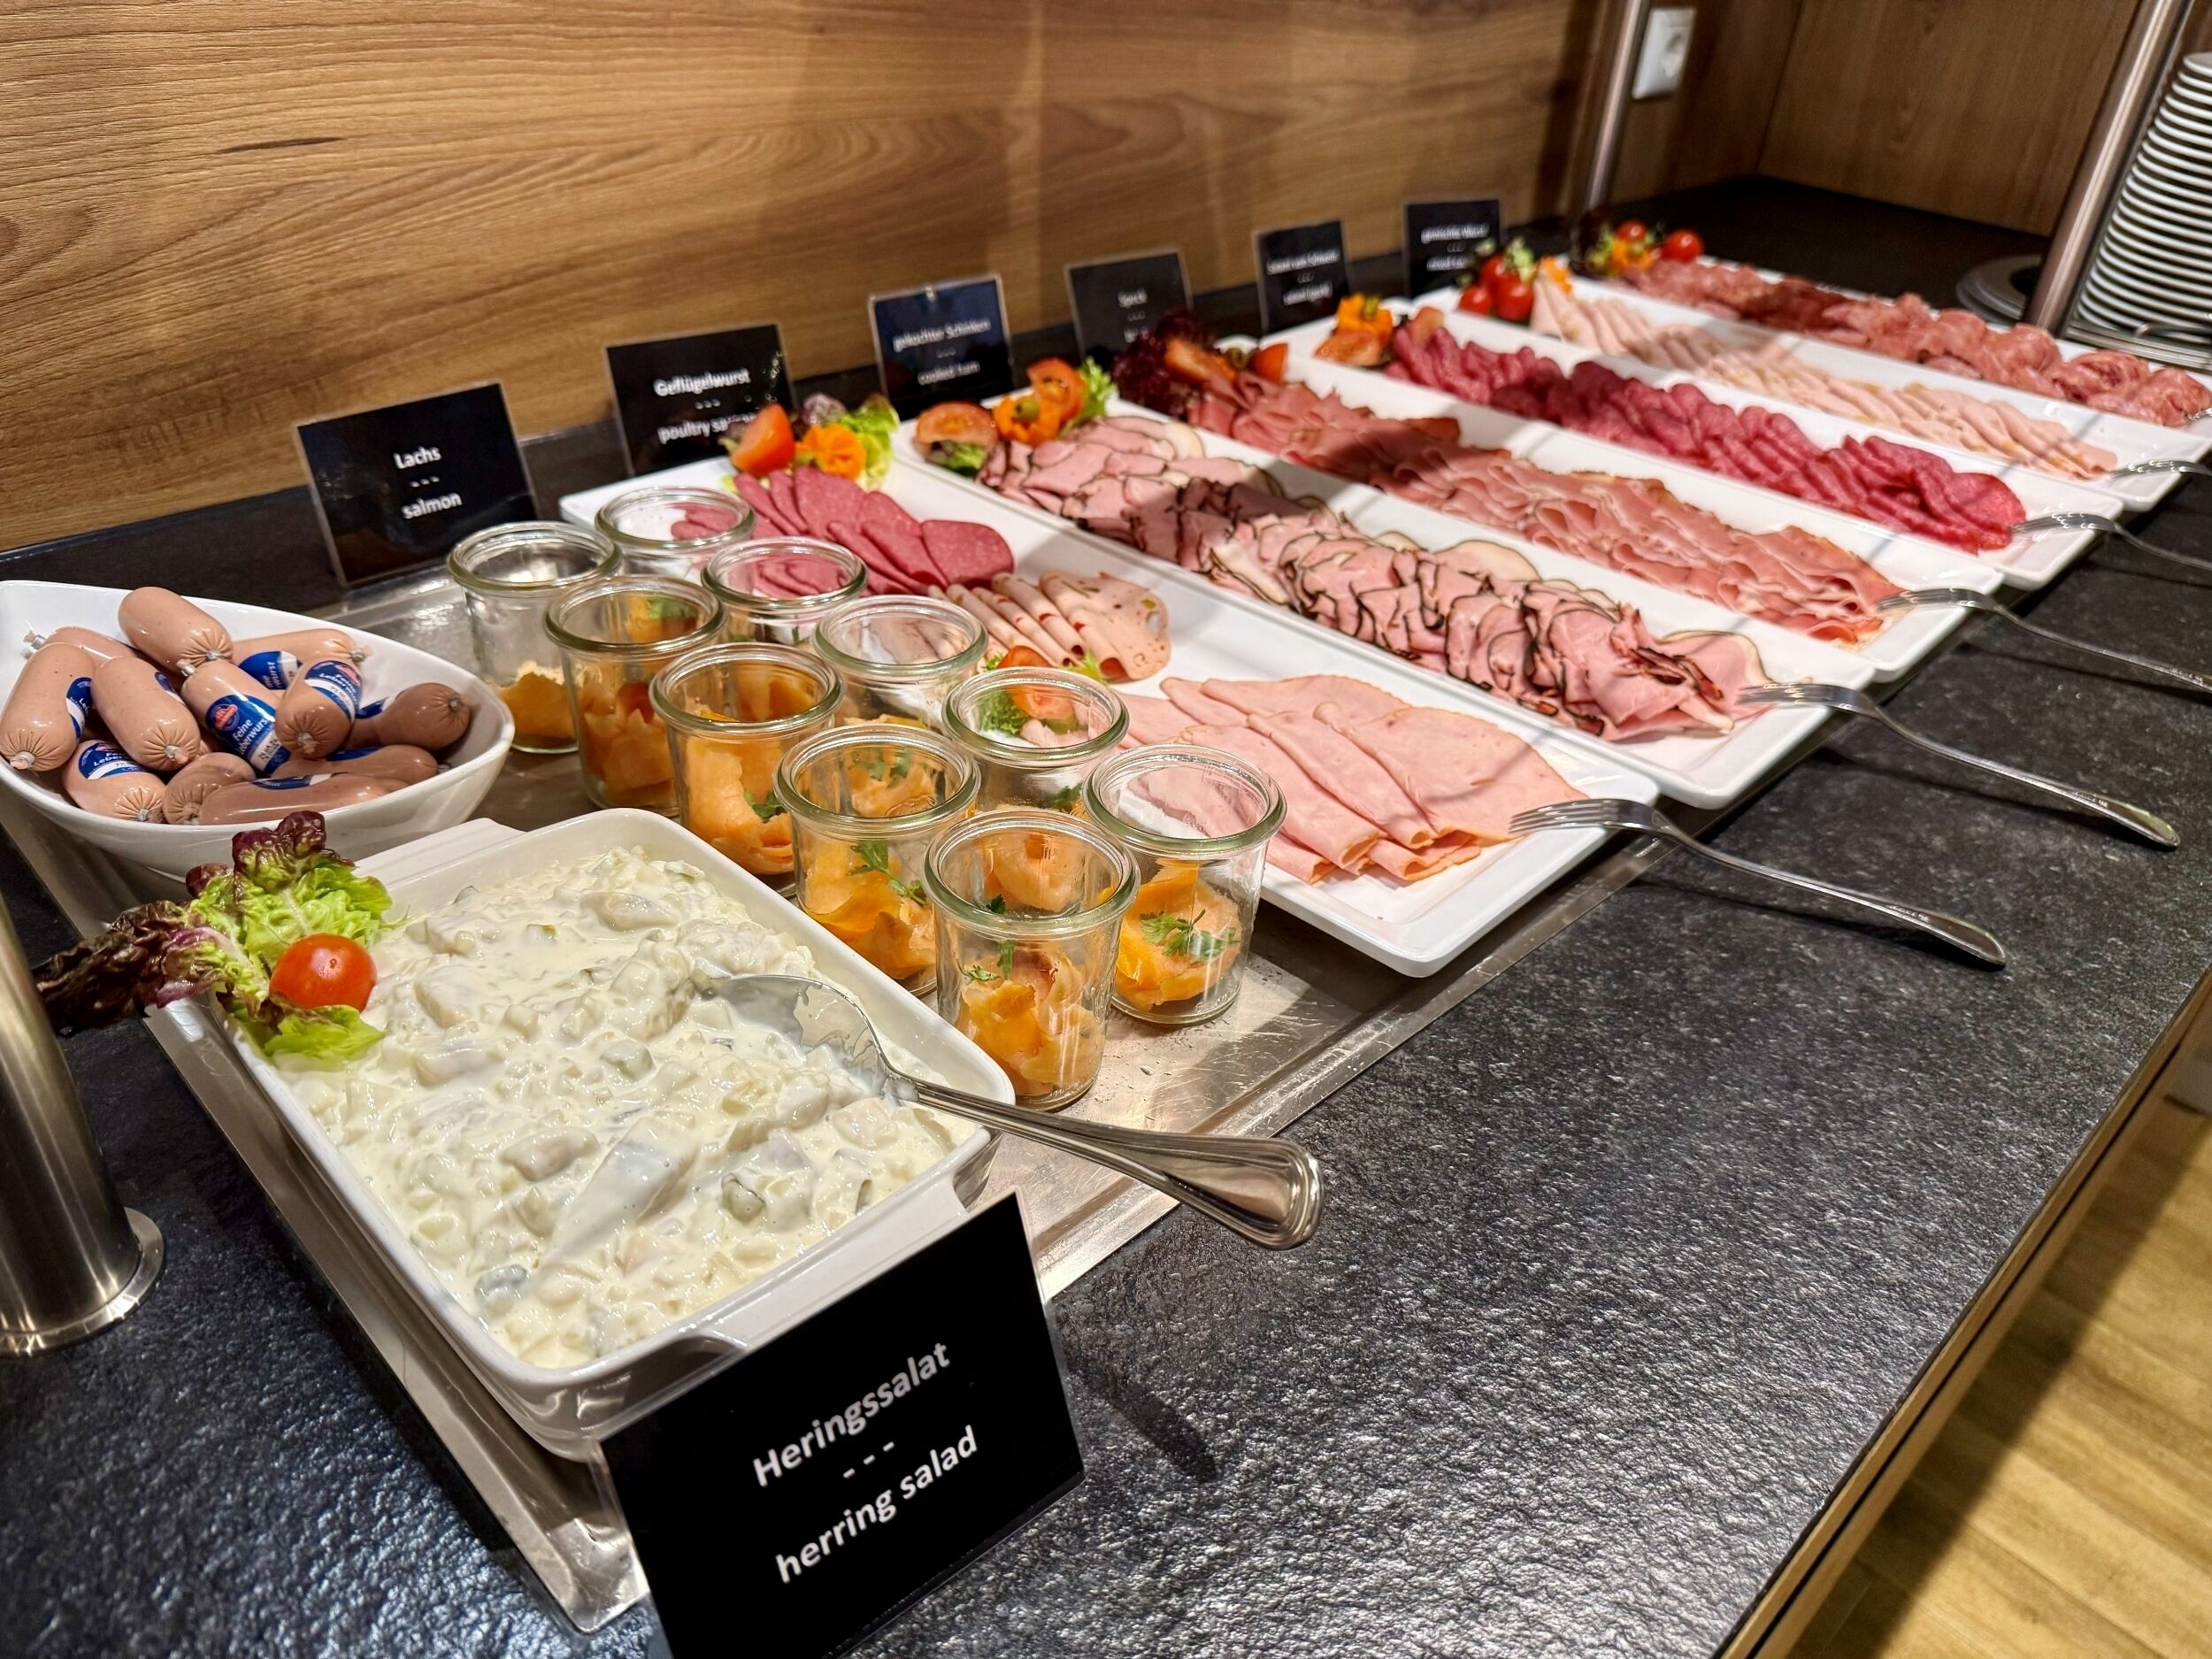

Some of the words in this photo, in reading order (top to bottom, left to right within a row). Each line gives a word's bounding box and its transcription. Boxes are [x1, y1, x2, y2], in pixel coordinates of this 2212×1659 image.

[654, 367, 750, 396] Geflügelwurst
[657, 421, 710, 444] poultry
[393, 446, 442, 469] Lachs
[401, 493, 462, 519] salmon
[233, 718, 253, 741] Feine
[752, 1342, 951, 1487] Heringssalat
[775, 1489, 897, 1584] herring
[899, 1425, 978, 1500] salad
